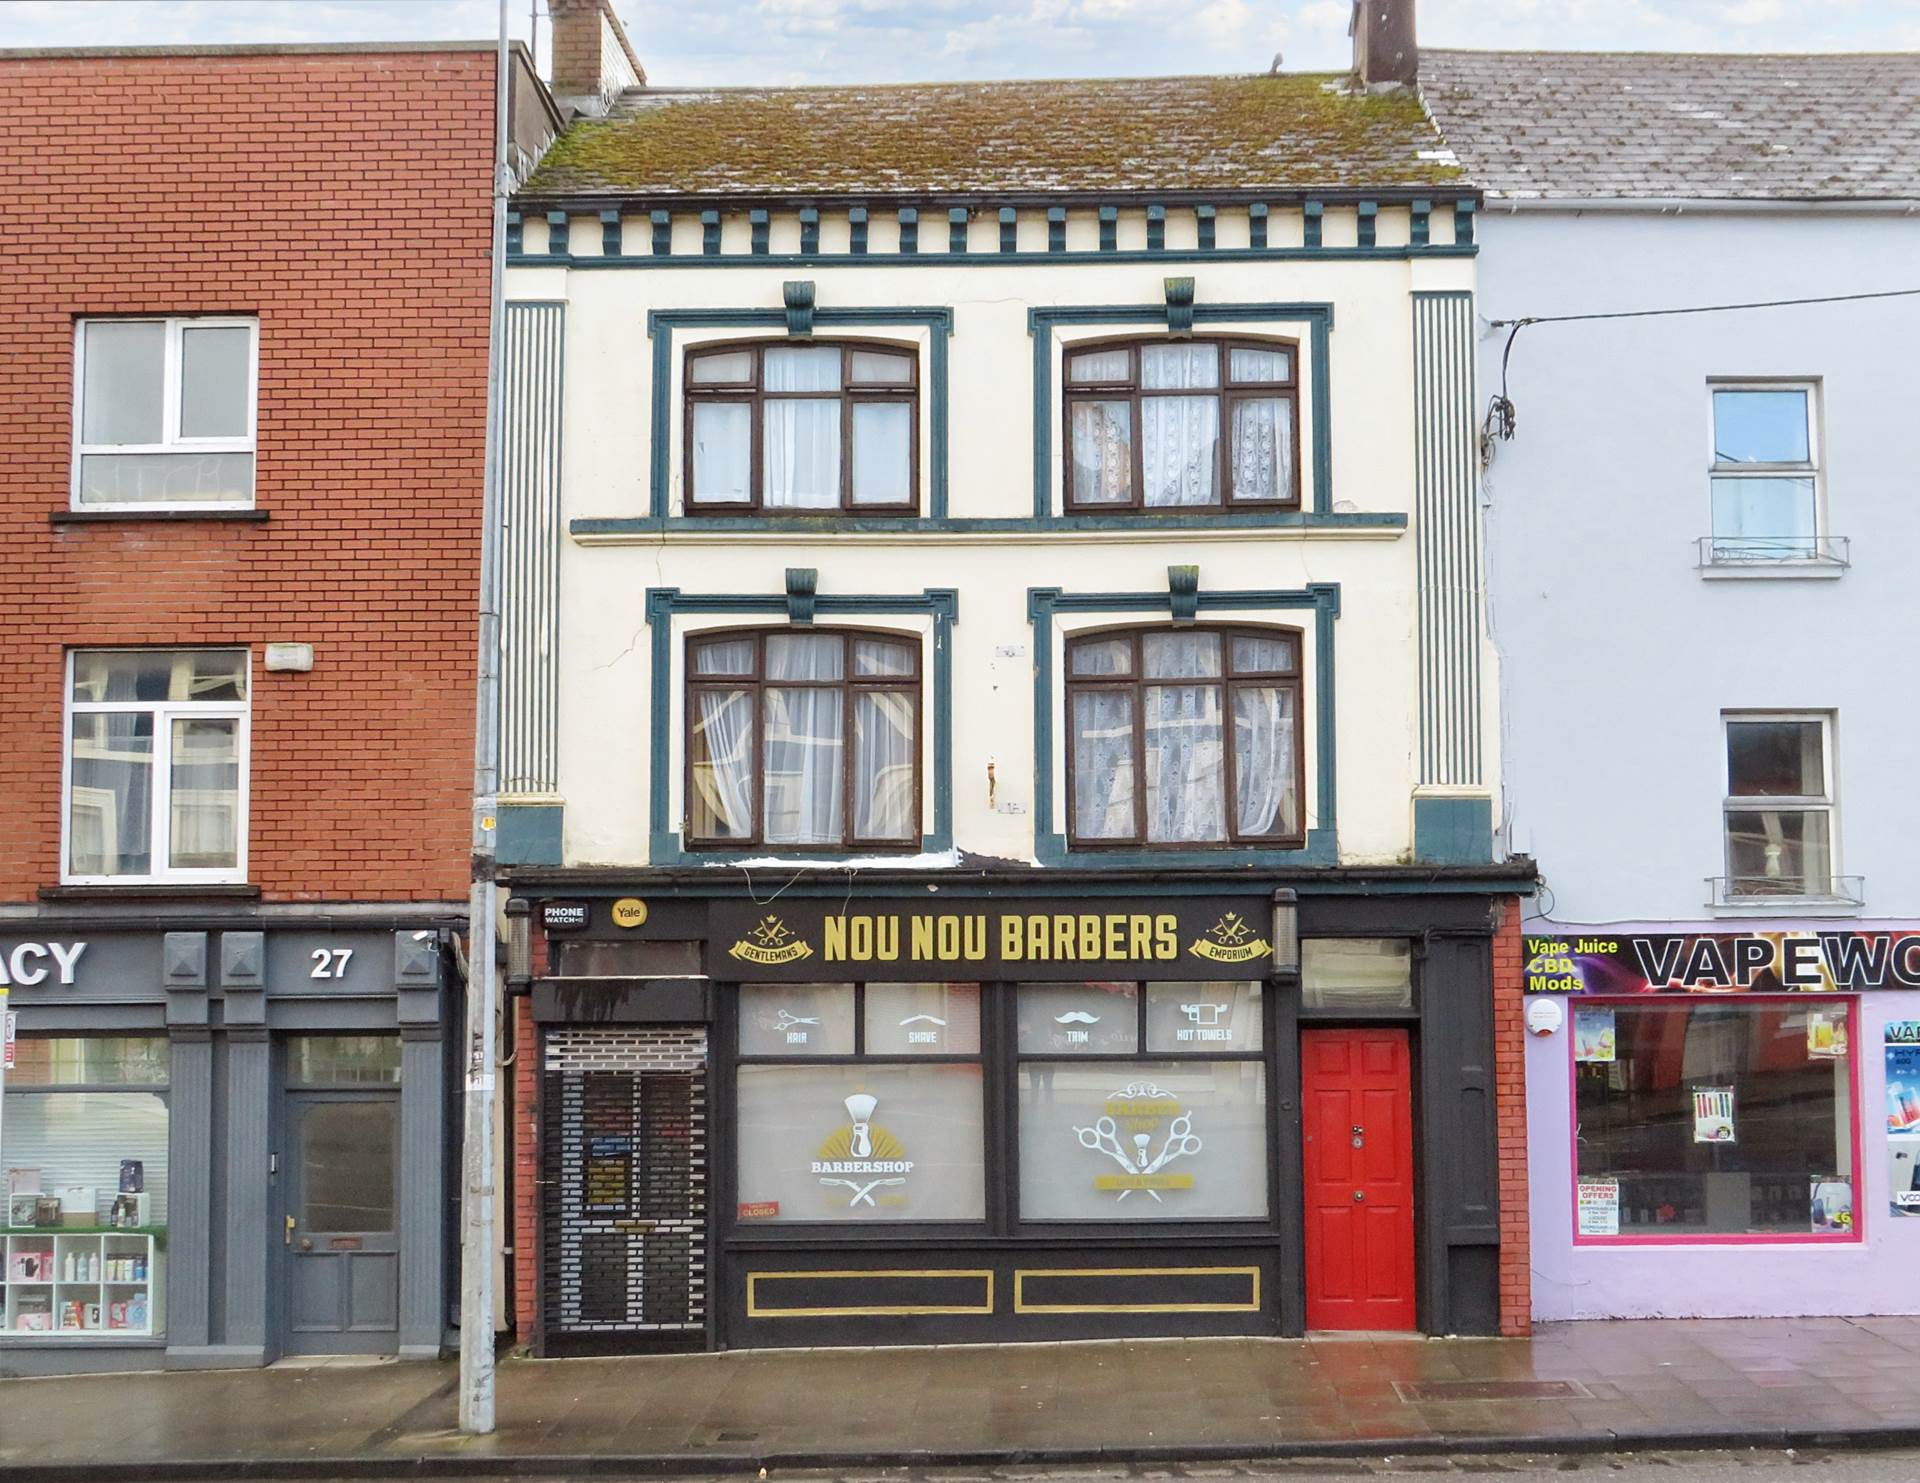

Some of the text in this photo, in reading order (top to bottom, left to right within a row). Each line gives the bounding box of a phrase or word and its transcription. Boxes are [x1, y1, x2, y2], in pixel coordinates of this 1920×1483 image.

[545, 908, 584, 917] PHONE
[618, 907, 641, 918] Yale
[824, 914, 1178, 961] NOU NOU BARBERS
[1209, 946, 1253, 960] EMPORIUM
[1528, 938, 1618, 957] Vape Juice
[0, 942, 87, 985] CY
[311, 948, 353, 978] 27
[1529, 957, 1573, 974] CBD
[1529, 975, 1584, 991] Mods
[786, 1031, 807, 1044] HAIR
[908, 1031, 937, 1044] SHAVE
[1067, 1030, 1089, 1043] TRIM
[1177, 1029, 1232, 1041] HOT TOWELS
[811, 1161, 914, 1174] BARBERSHOP
